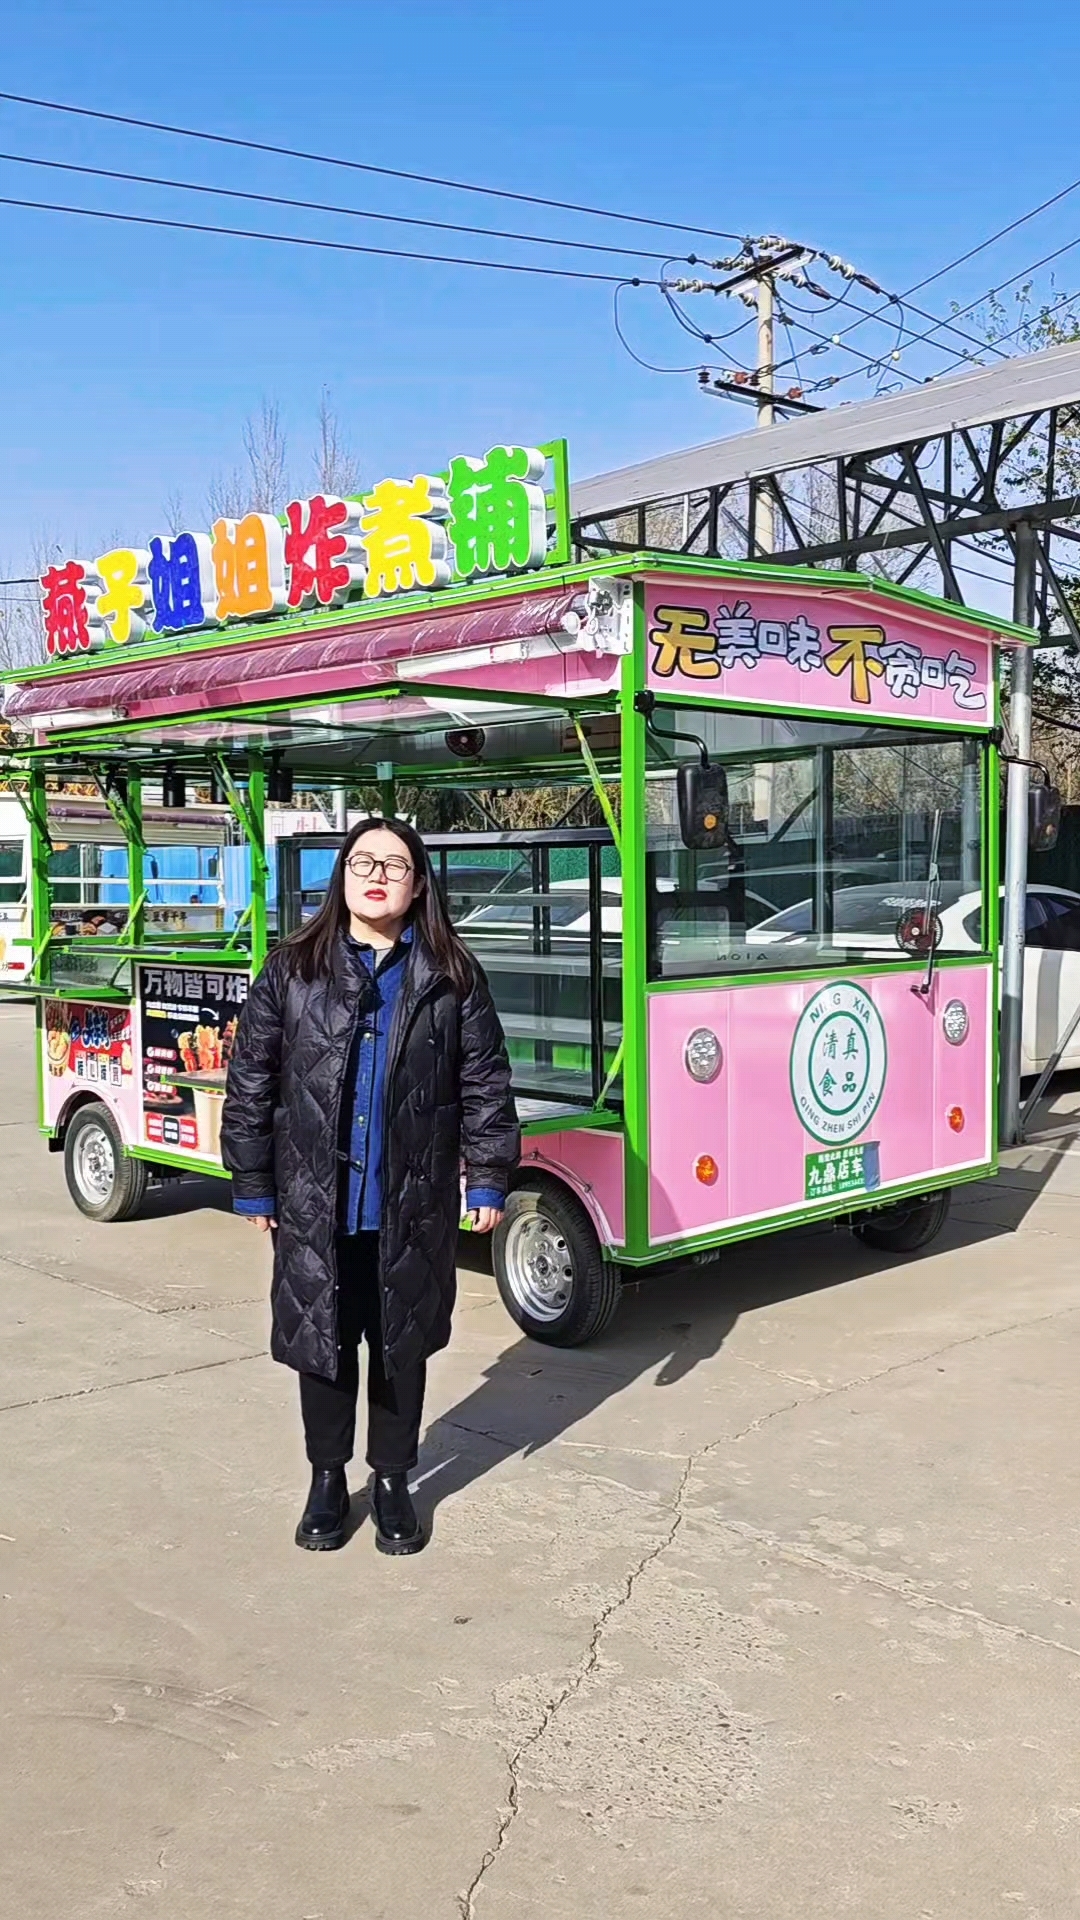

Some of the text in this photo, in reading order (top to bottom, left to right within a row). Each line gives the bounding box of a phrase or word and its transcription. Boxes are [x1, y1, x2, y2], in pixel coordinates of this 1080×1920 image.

[40, 445, 540, 656] 燕子姐姐炸煮铺
[649, 600, 986, 710] 无美味不贪吃
[144, 969, 248, 1004] 万物皆可炸
[809, 993, 871, 1024] NIG XIA
[823, 1028, 859, 1060] 清真
[818, 1068, 857, 1097] 食品
[800, 1092, 876, 1133] QING ZHEN SHI PIN
